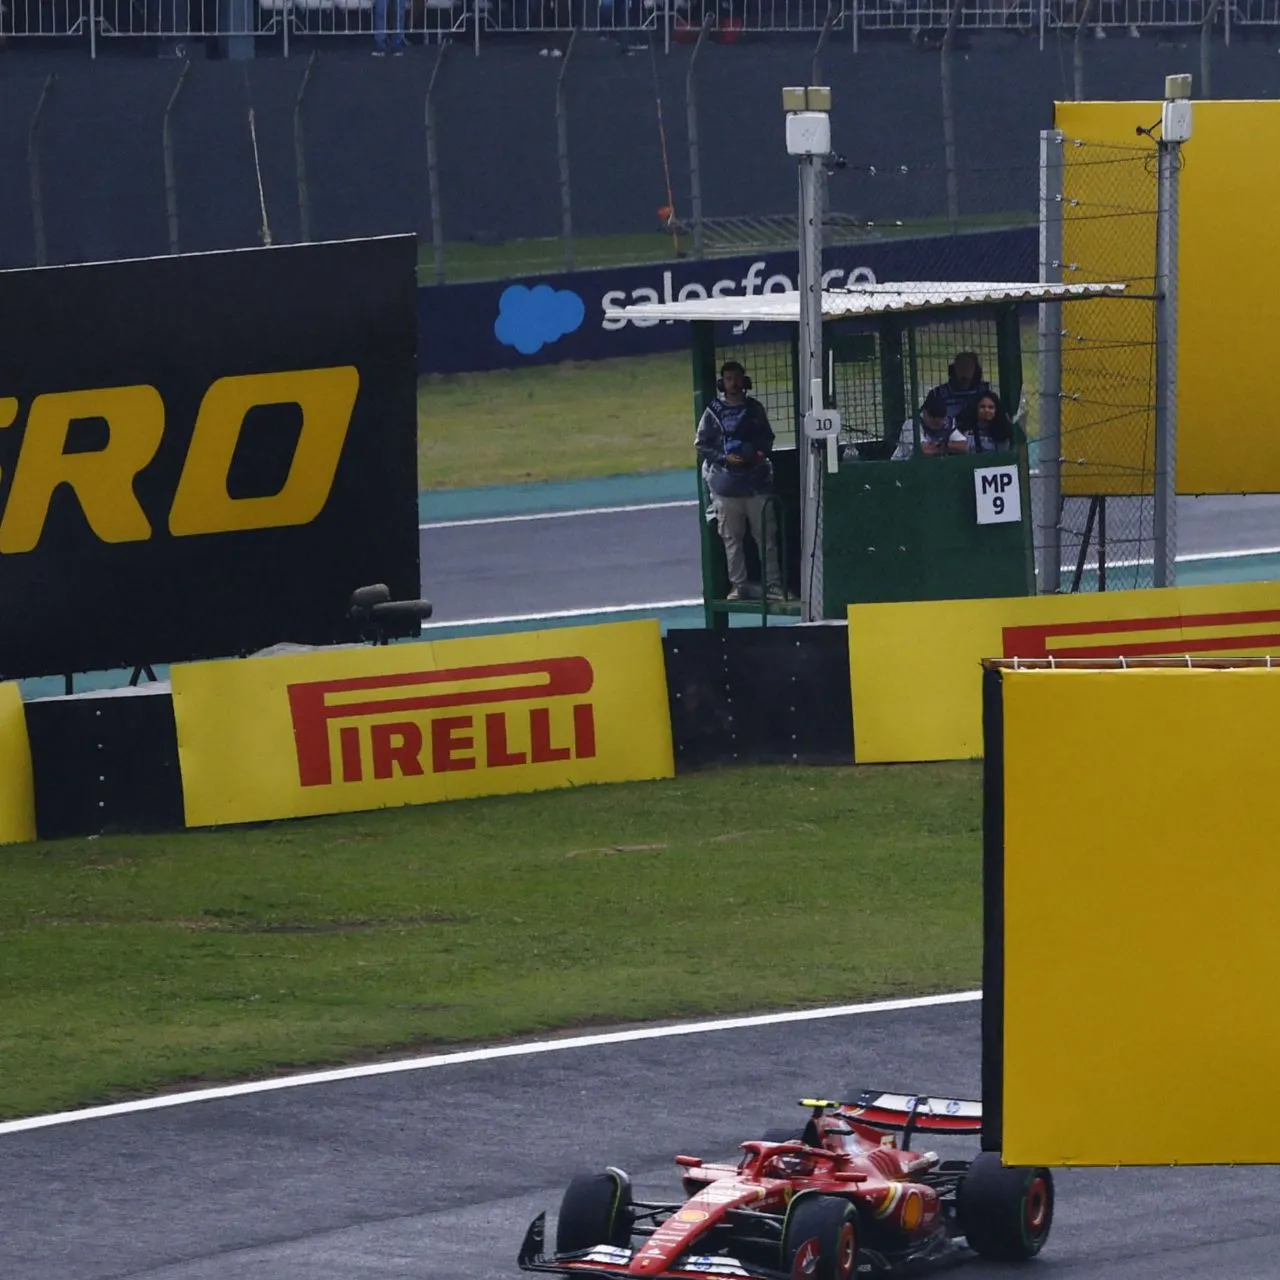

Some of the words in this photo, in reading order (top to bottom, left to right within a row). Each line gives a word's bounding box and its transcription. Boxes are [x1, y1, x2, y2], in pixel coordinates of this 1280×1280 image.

[815, 419, 833, 431] 10
[0, 365, 360, 554] RO
[981, 473, 1012, 495] MP
[993, 496, 1005, 515] 9
[287, 656, 597, 787] PIRELLI
